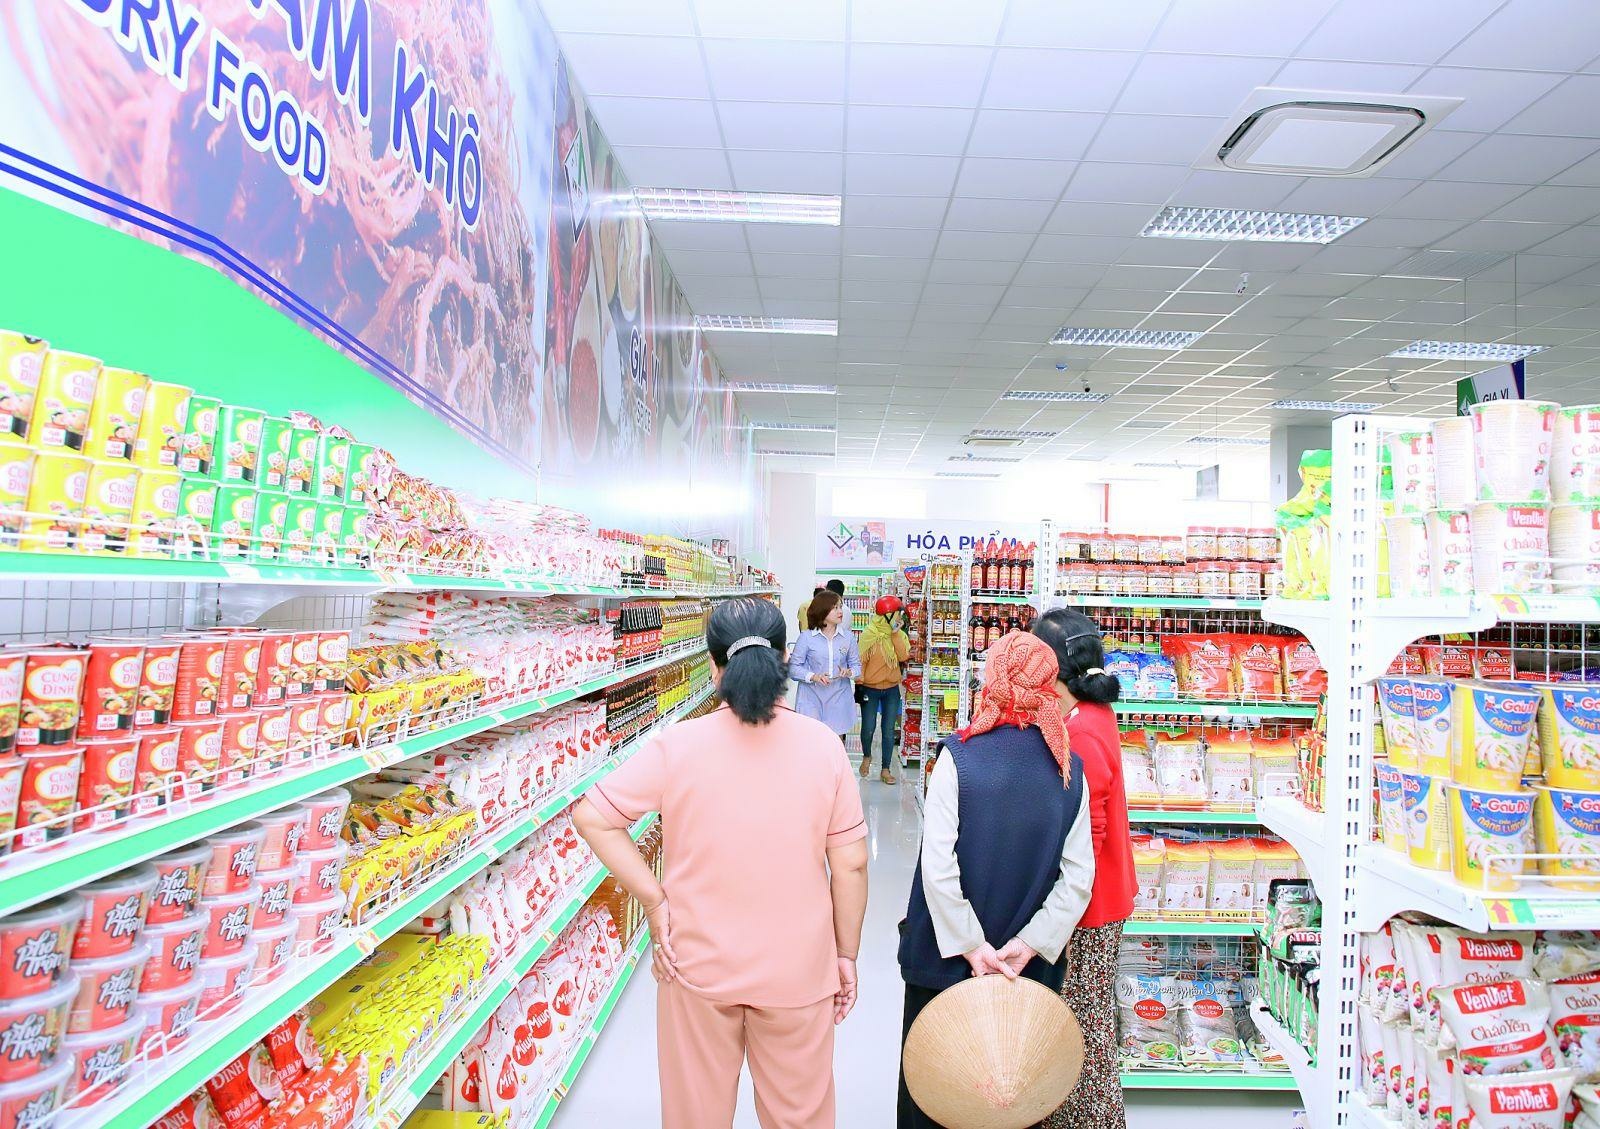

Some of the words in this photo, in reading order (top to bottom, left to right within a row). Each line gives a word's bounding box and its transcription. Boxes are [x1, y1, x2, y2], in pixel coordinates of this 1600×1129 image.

[212, 40, 326, 187] FOOD
[907, 530, 951, 550] HÓA
[41, 671, 78, 683] CUNG
[1465, 939, 1517, 958] YenViet
[1461, 984, 1518, 1012] YenViet
[1495, 1087, 1551, 1111] YenViet
